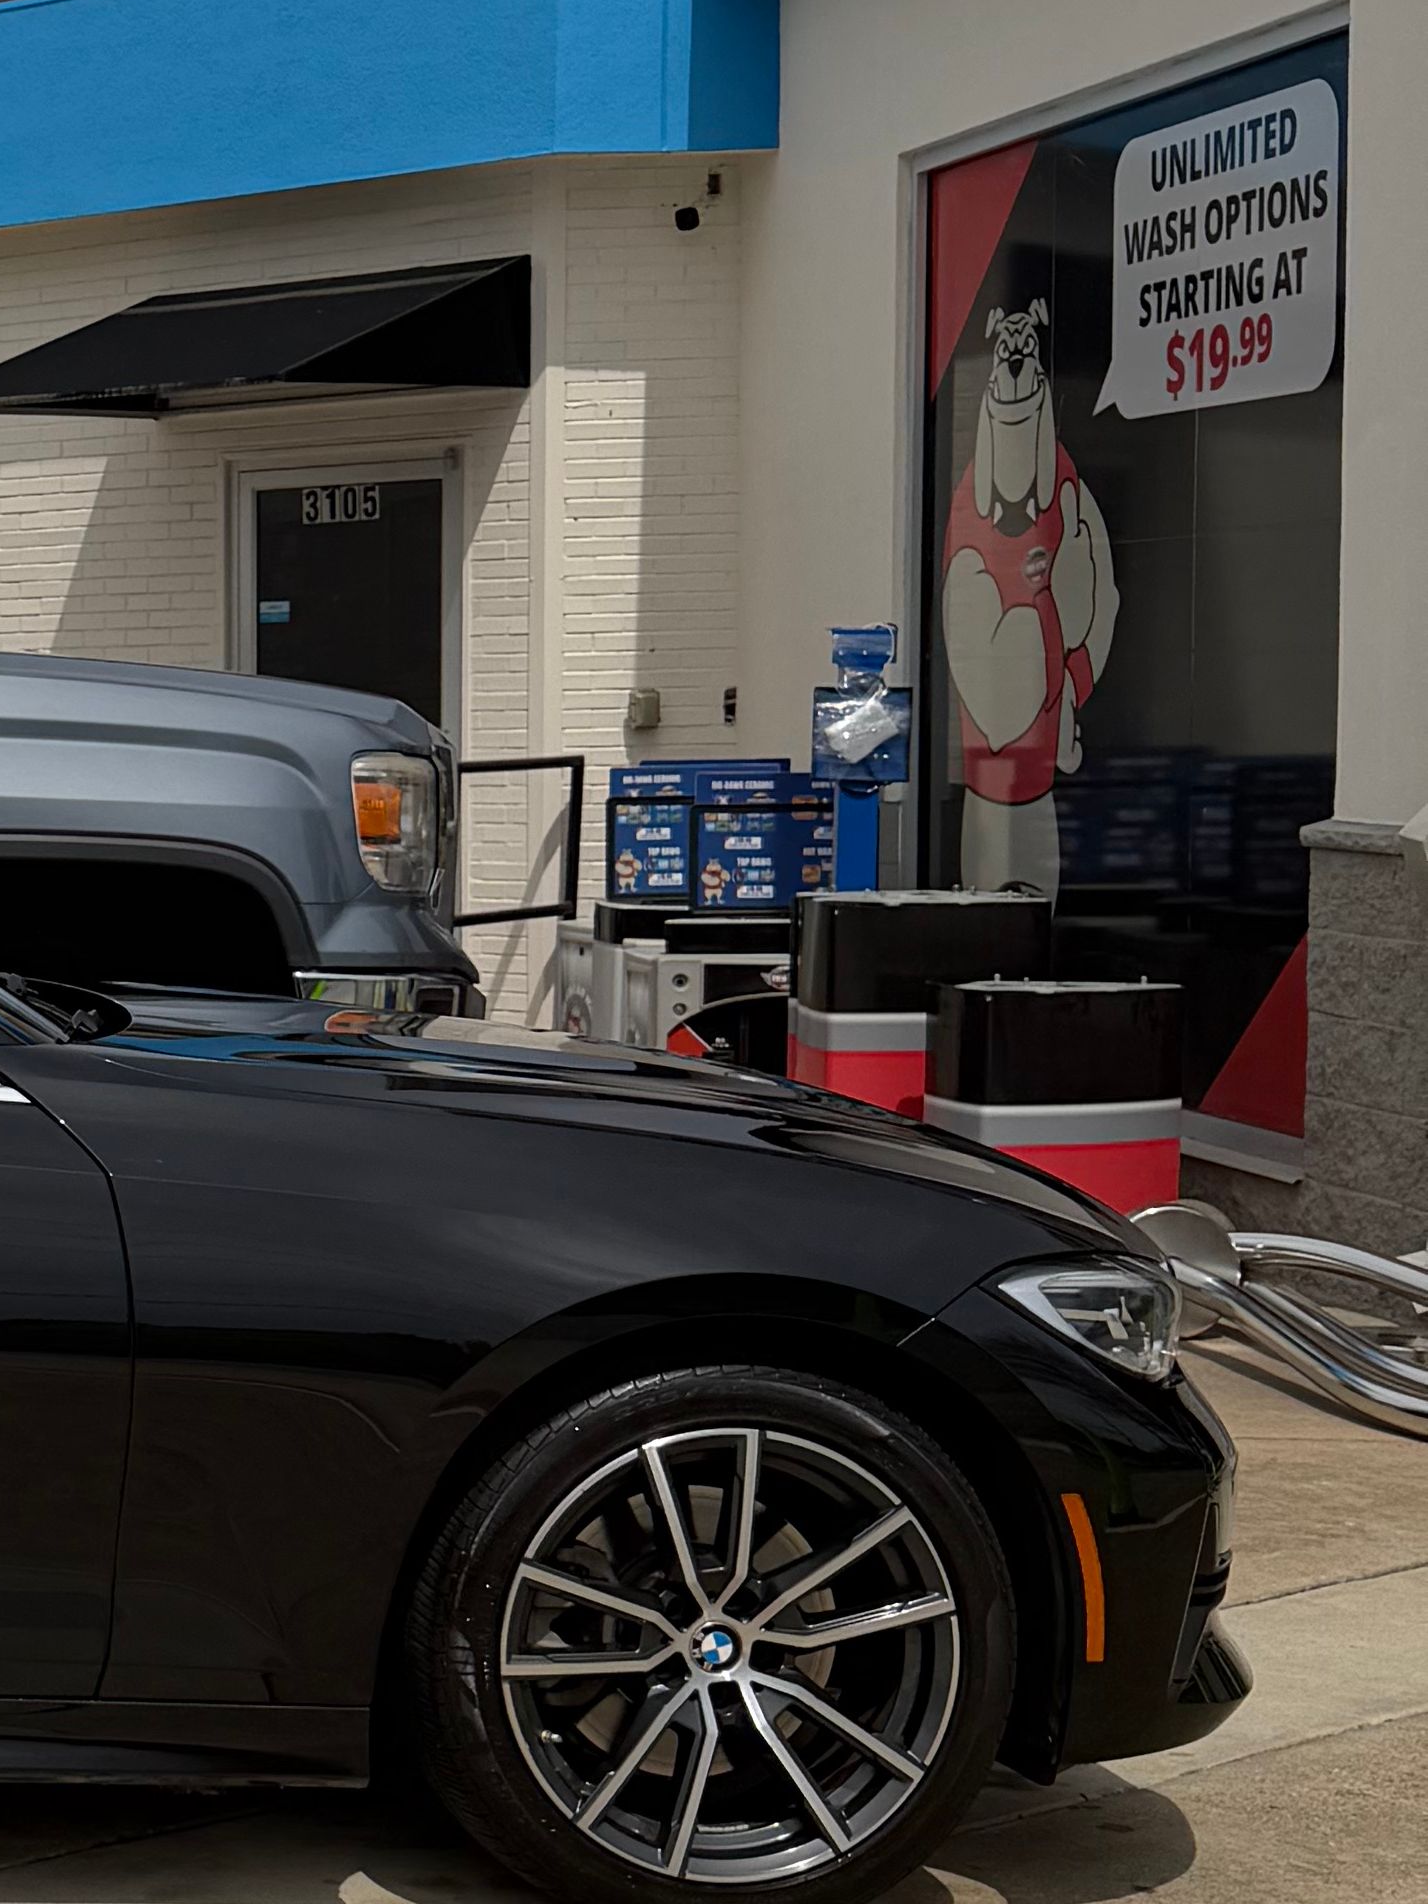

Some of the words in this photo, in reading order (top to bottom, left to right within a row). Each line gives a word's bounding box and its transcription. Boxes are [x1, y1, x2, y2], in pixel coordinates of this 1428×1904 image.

[1150, 107, 1299, 193] UNLIMITED
[1123, 205, 1197, 266] WASH
[1203, 168, 1330, 245] OPTIONS
[1138, 256, 1265, 329] STARTING
[1271, 246, 1309, 301] AT
[1164, 311, 1274, 401] $19.99
[304, 487, 378, 523] 3105
